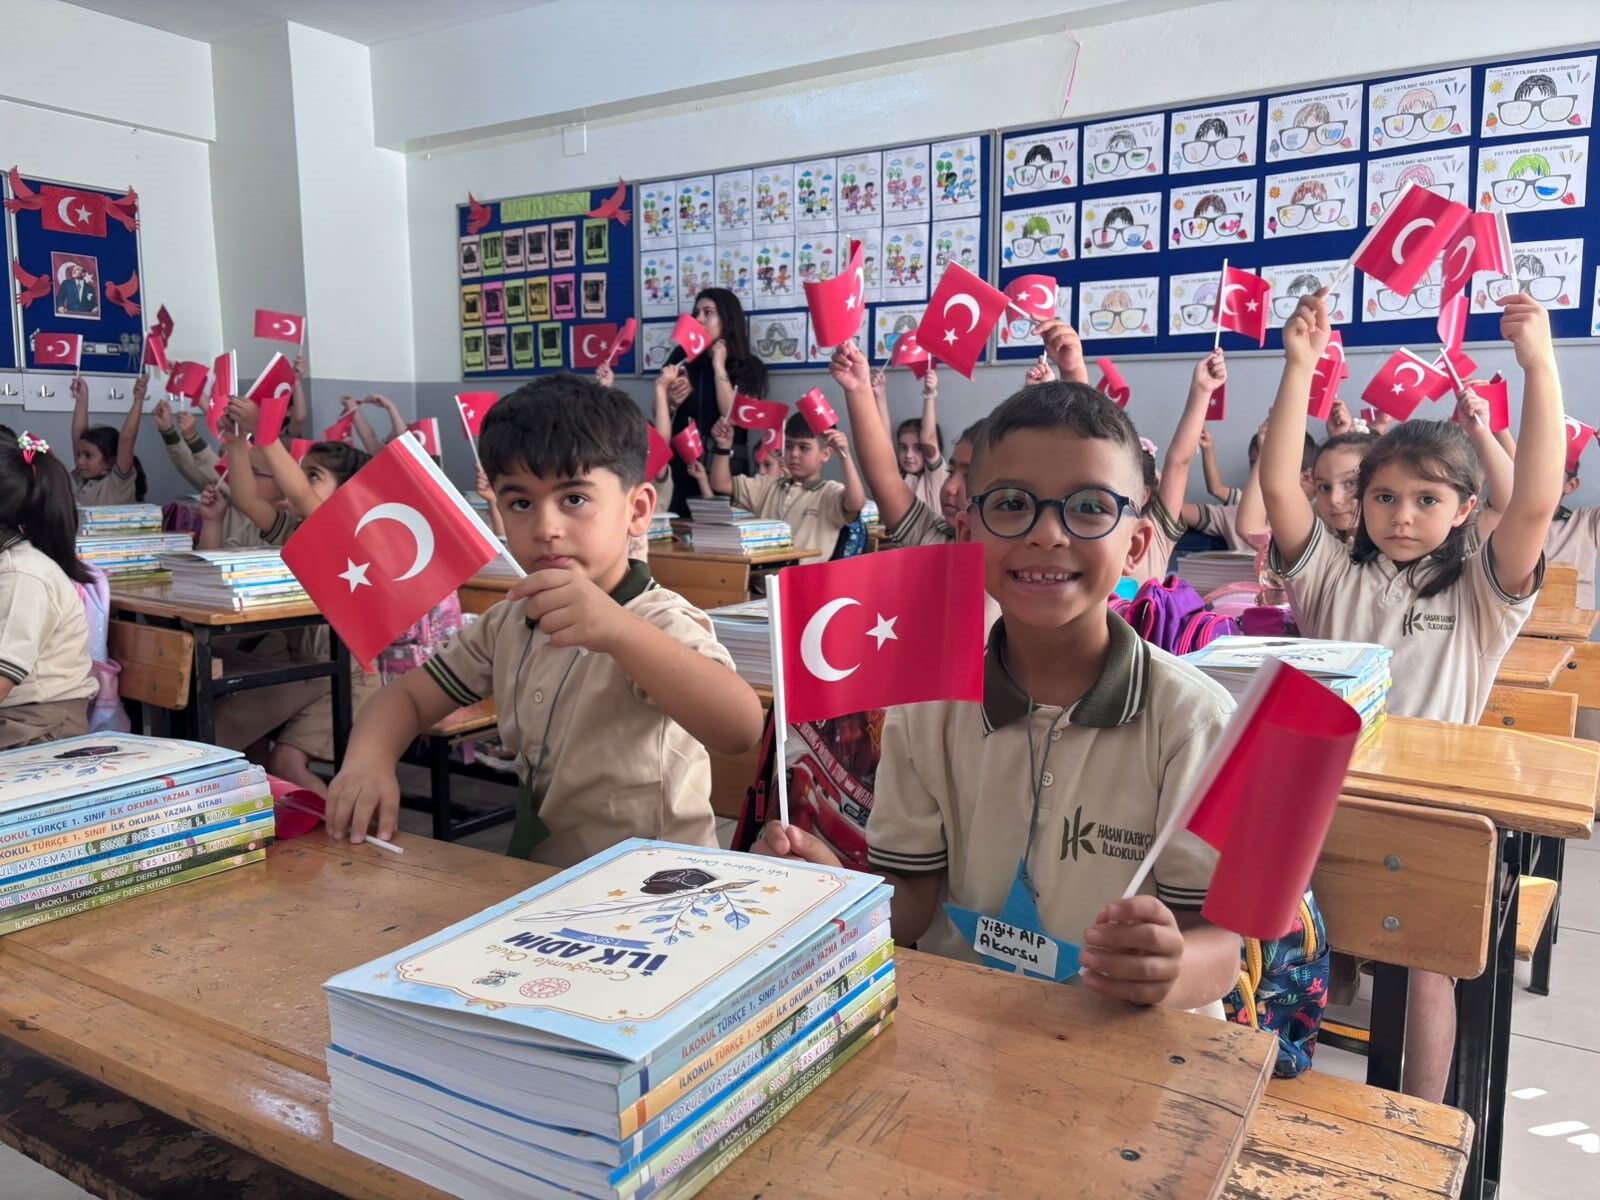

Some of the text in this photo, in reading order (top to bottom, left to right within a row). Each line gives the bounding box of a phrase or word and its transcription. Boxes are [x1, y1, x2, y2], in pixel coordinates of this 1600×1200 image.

[32, 819, 67, 836] TÜRKÇE
[72, 818, 80, 827] 1.
[84, 811, 106, 823] SINIF
[110, 806, 124, 817] İLK
[127, 798, 159, 812] OKUMA
[162, 790, 191, 802] YAZMA
[195, 782, 220, 795] KİTABI
[32, 834, 69, 852] TÜRKÇE
[73, 833, 81, 842] 1.
[85, 826, 107, 839] SINIF
[111, 821, 125, 832] İLK
[128, 813, 160, 827] OKUMA
[163, 805, 193, 817] YAZMA
[197, 797, 222, 809] KİTABI
[1097, 823, 1122, 843] HASAN
[18, 847, 84, 872] MATEMATİK
[131, 829, 156, 844] DERS
[161, 818, 192, 835] KİTABI
[1102, 841, 1145, 861] İLKOKULU
[20, 879, 86, 903] MATEMATİK
[133, 857, 158, 872] DERS
[162, 847, 193, 865] KİTABI
[34, 896, 70, 911] İLKOKUL
[71, 885, 104, 901] TÜRKÇE
[114, 877, 133, 888] SINIF
[136, 870, 157, 882] DERS
[159, 863, 182, 876] KİTABI
[766, 868, 789, 878] Veli
[15, 913, 53, 930] İLKOKUL
[54, 901, 89, 919] TÜRKÇE
[99, 893, 121, 905] SINIF
[122, 885, 145, 898] DERS
[147, 878, 172, 891] KİTABI
[981, 918, 1014, 938] Yiğit
[486, 944, 631, 982] Çocuğumla Okula
[503, 931, 668, 977] İLK ADIM
[980, 933, 1038, 964] Akarsu
[682, 927, 859, 1058] İLKOKUL TÜRKÇE 1. SINIF İLK OKUMA YAZMA KİTABI
[679, 1058, 715, 1089] İLKOKUL
[715, 1032, 744, 1062] TÜRKÇE
[747, 1028, 754, 1038] 1.
[756, 1012, 774, 1033] SINIF
[776, 1003, 788, 1017] İLK
[789, 986, 814, 1007] OKUMA
[815, 967, 836, 988] YAZMA
[839, 950, 857, 972] KİTABI
[660, 1090, 703, 1134] İLKOKUL
[706, 1050, 760, 1096] MATEMATİK
[719, 1123, 748, 1151] İLKOKUL
[748, 1100, 775, 1126] TÜRKÇE
[782, 1082, 799, 1100] SINIF
[799, 1067, 815, 1086] DERS
[816, 1051, 834, 1072] KİTABI
[703, 1097, 758, 1148] MATEMATİK
[713, 1145, 744, 1176] İLKOKUL
[745, 1119, 772, 1148] TÜRKÇE
